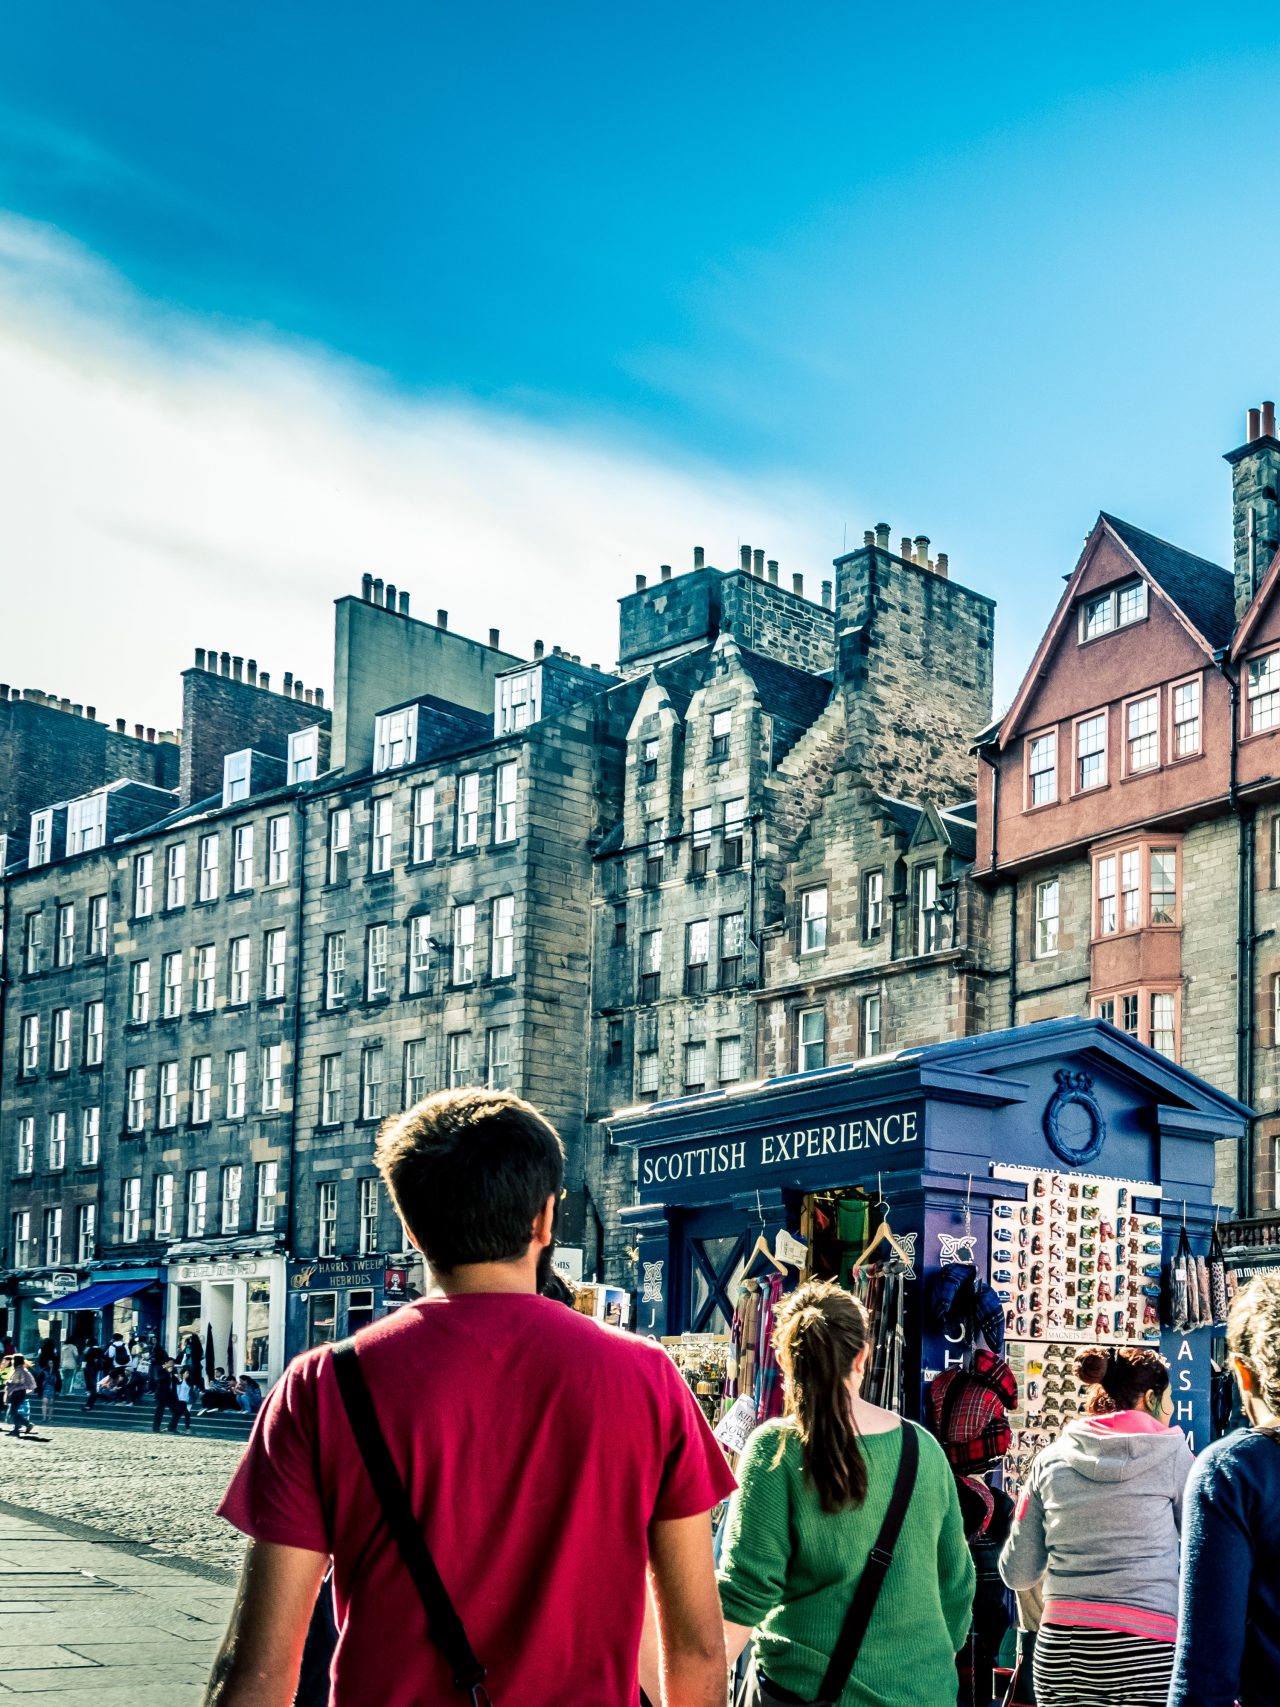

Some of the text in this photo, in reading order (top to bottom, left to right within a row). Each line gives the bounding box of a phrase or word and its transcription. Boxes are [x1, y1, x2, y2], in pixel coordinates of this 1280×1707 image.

[643, 1111, 918, 1185] SCOTTISH EXPERIENCE
[319, 1262, 349, 1274] HARRIS
[329, 1274, 372, 1287] HEBRIDES
